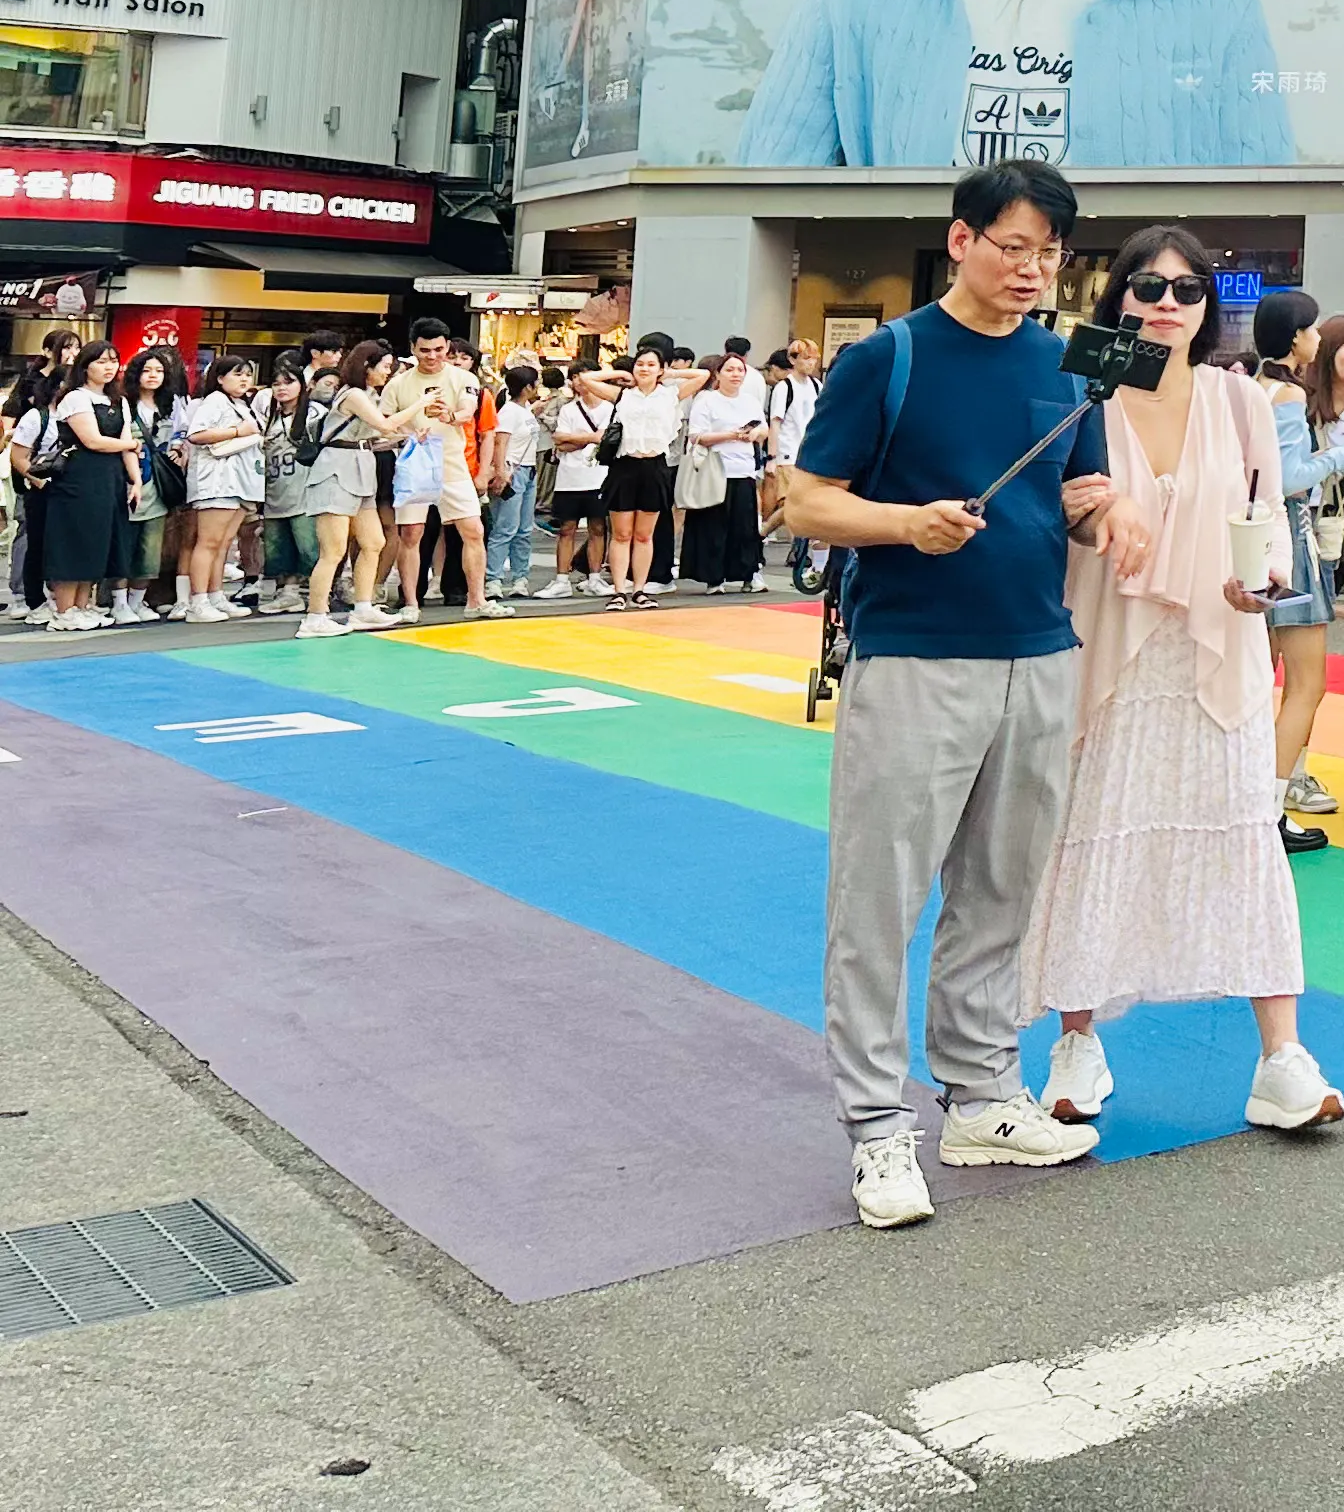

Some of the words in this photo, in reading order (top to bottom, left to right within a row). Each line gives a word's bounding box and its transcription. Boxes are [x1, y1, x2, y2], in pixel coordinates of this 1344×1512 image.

[1250, 70, 1329, 95] 宋雨琦
[153, 179, 254, 211] JIGUANG
[259, 189, 325, 216] FRIED
[327, 195, 417, 225] CHICKEN
[1213, 272, 1262, 296] PEN
